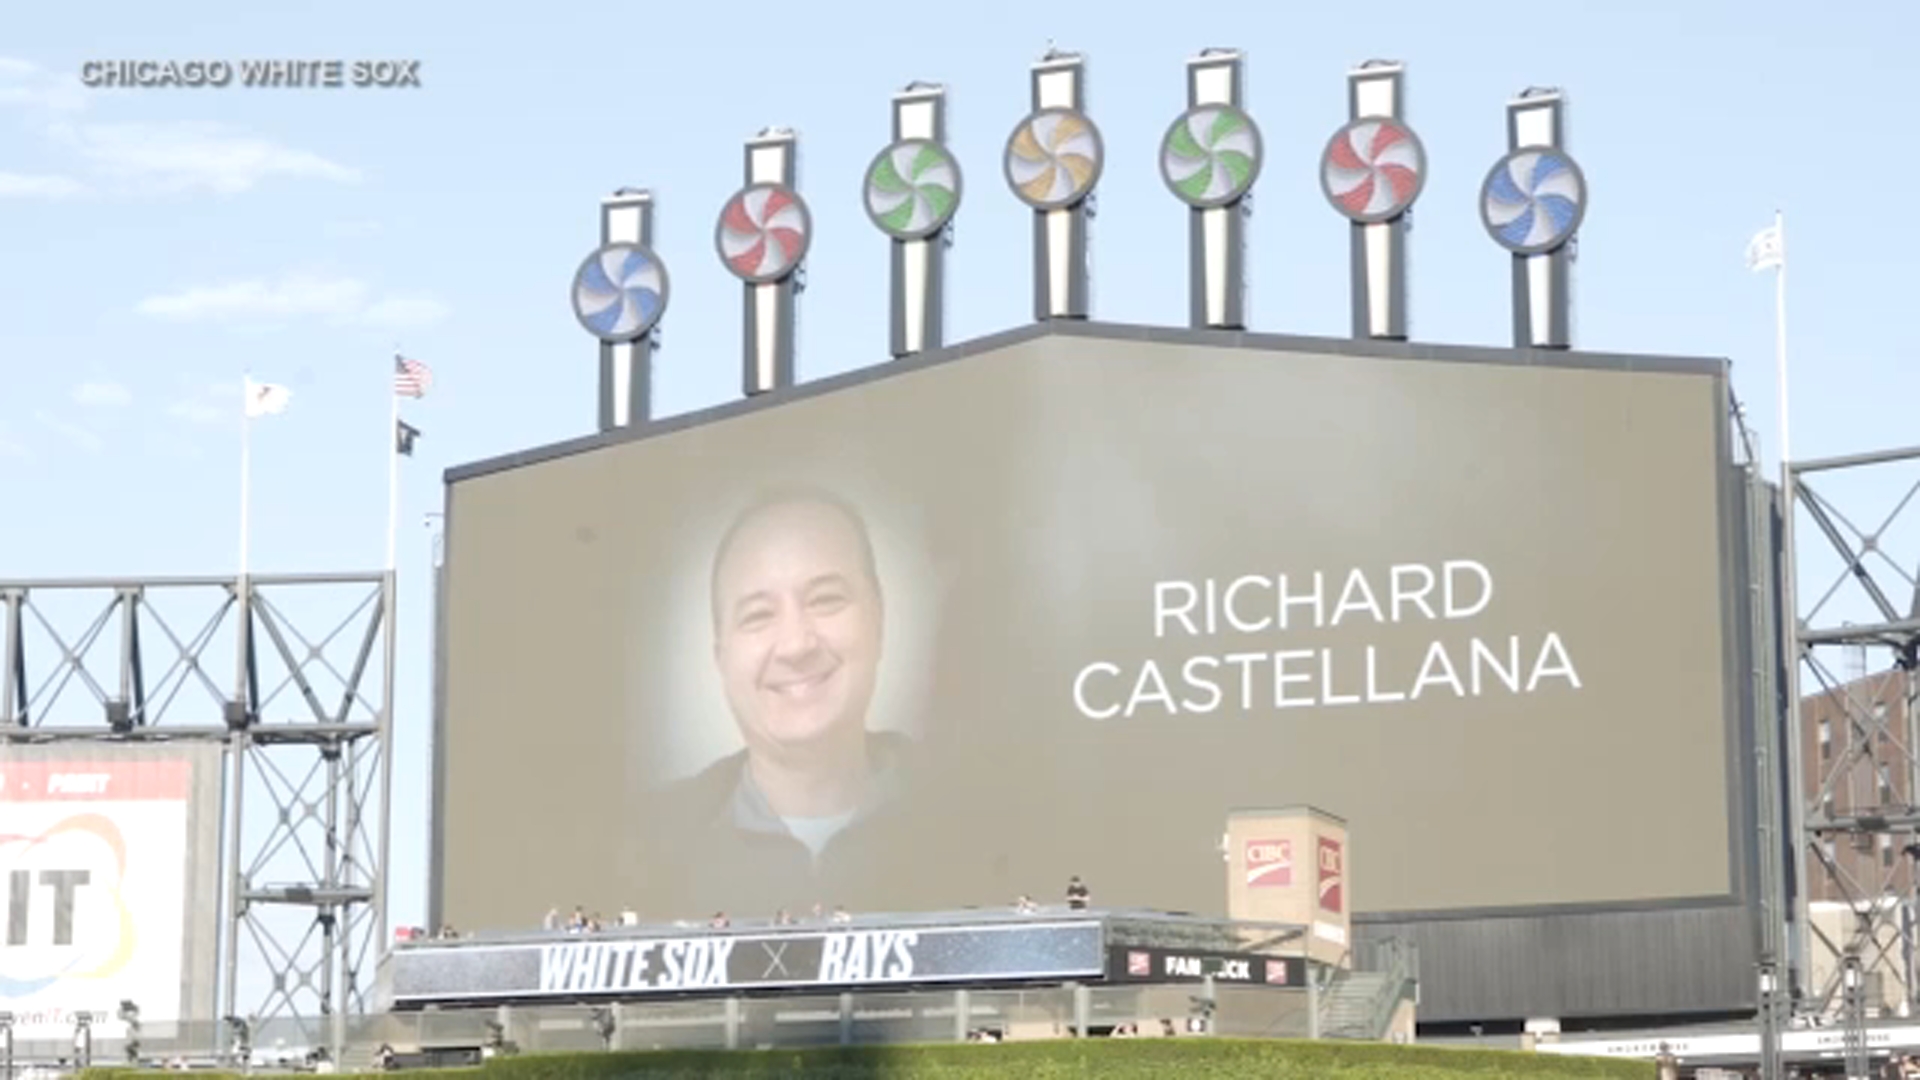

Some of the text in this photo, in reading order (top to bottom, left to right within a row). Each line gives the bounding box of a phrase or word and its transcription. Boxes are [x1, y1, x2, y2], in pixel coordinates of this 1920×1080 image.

[1153, 559, 1493, 638] RICHARD
[1072, 632, 1582, 719] CASTELLANA
[539, 942, 654, 992] WHITE
[656, 939, 736, 987] SOX
[817, 932, 918, 981] RAYS
